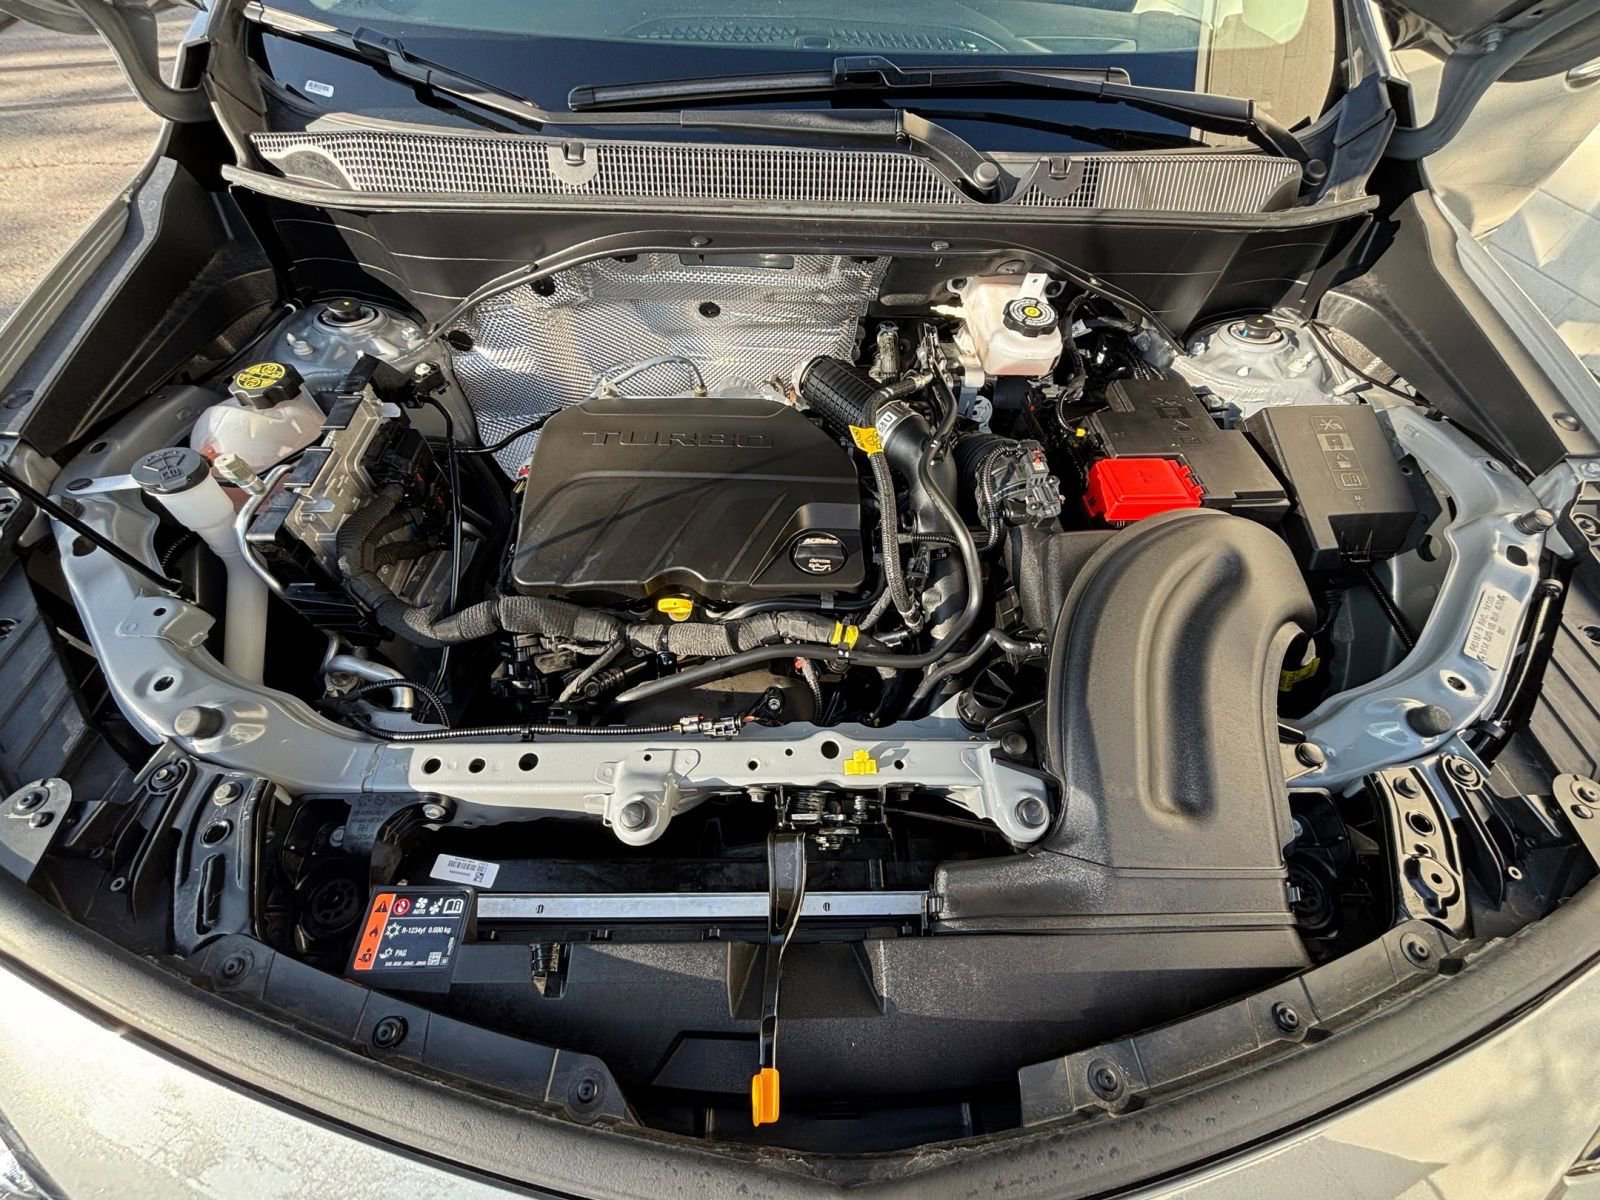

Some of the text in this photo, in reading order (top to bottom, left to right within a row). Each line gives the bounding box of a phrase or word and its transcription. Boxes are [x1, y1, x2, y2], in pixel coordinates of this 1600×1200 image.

[582, 431, 774, 449] TURBO
[401, 926, 427, 935] R-1234yf
[394, 949, 407, 957] PAG
